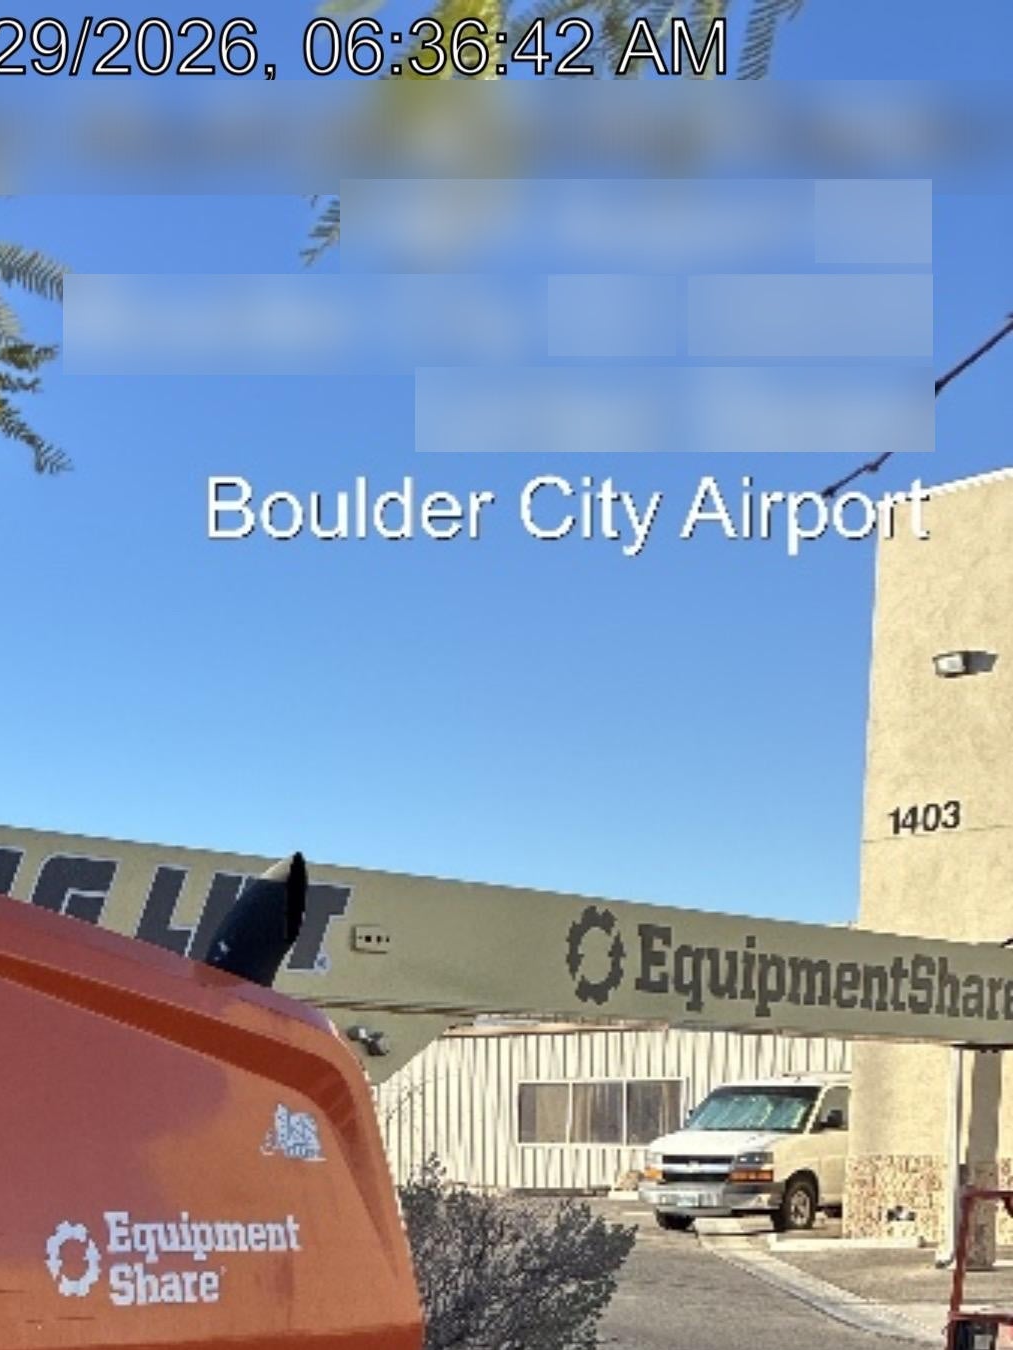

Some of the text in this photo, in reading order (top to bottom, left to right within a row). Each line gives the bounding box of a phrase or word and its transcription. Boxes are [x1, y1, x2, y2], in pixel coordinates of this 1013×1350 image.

[887, 800, 960, 835] 1403
[134, 864, 354, 972] LIT
[104, 1211, 300, 1263] Equipment
[108, 1262, 221, 1306] Share
